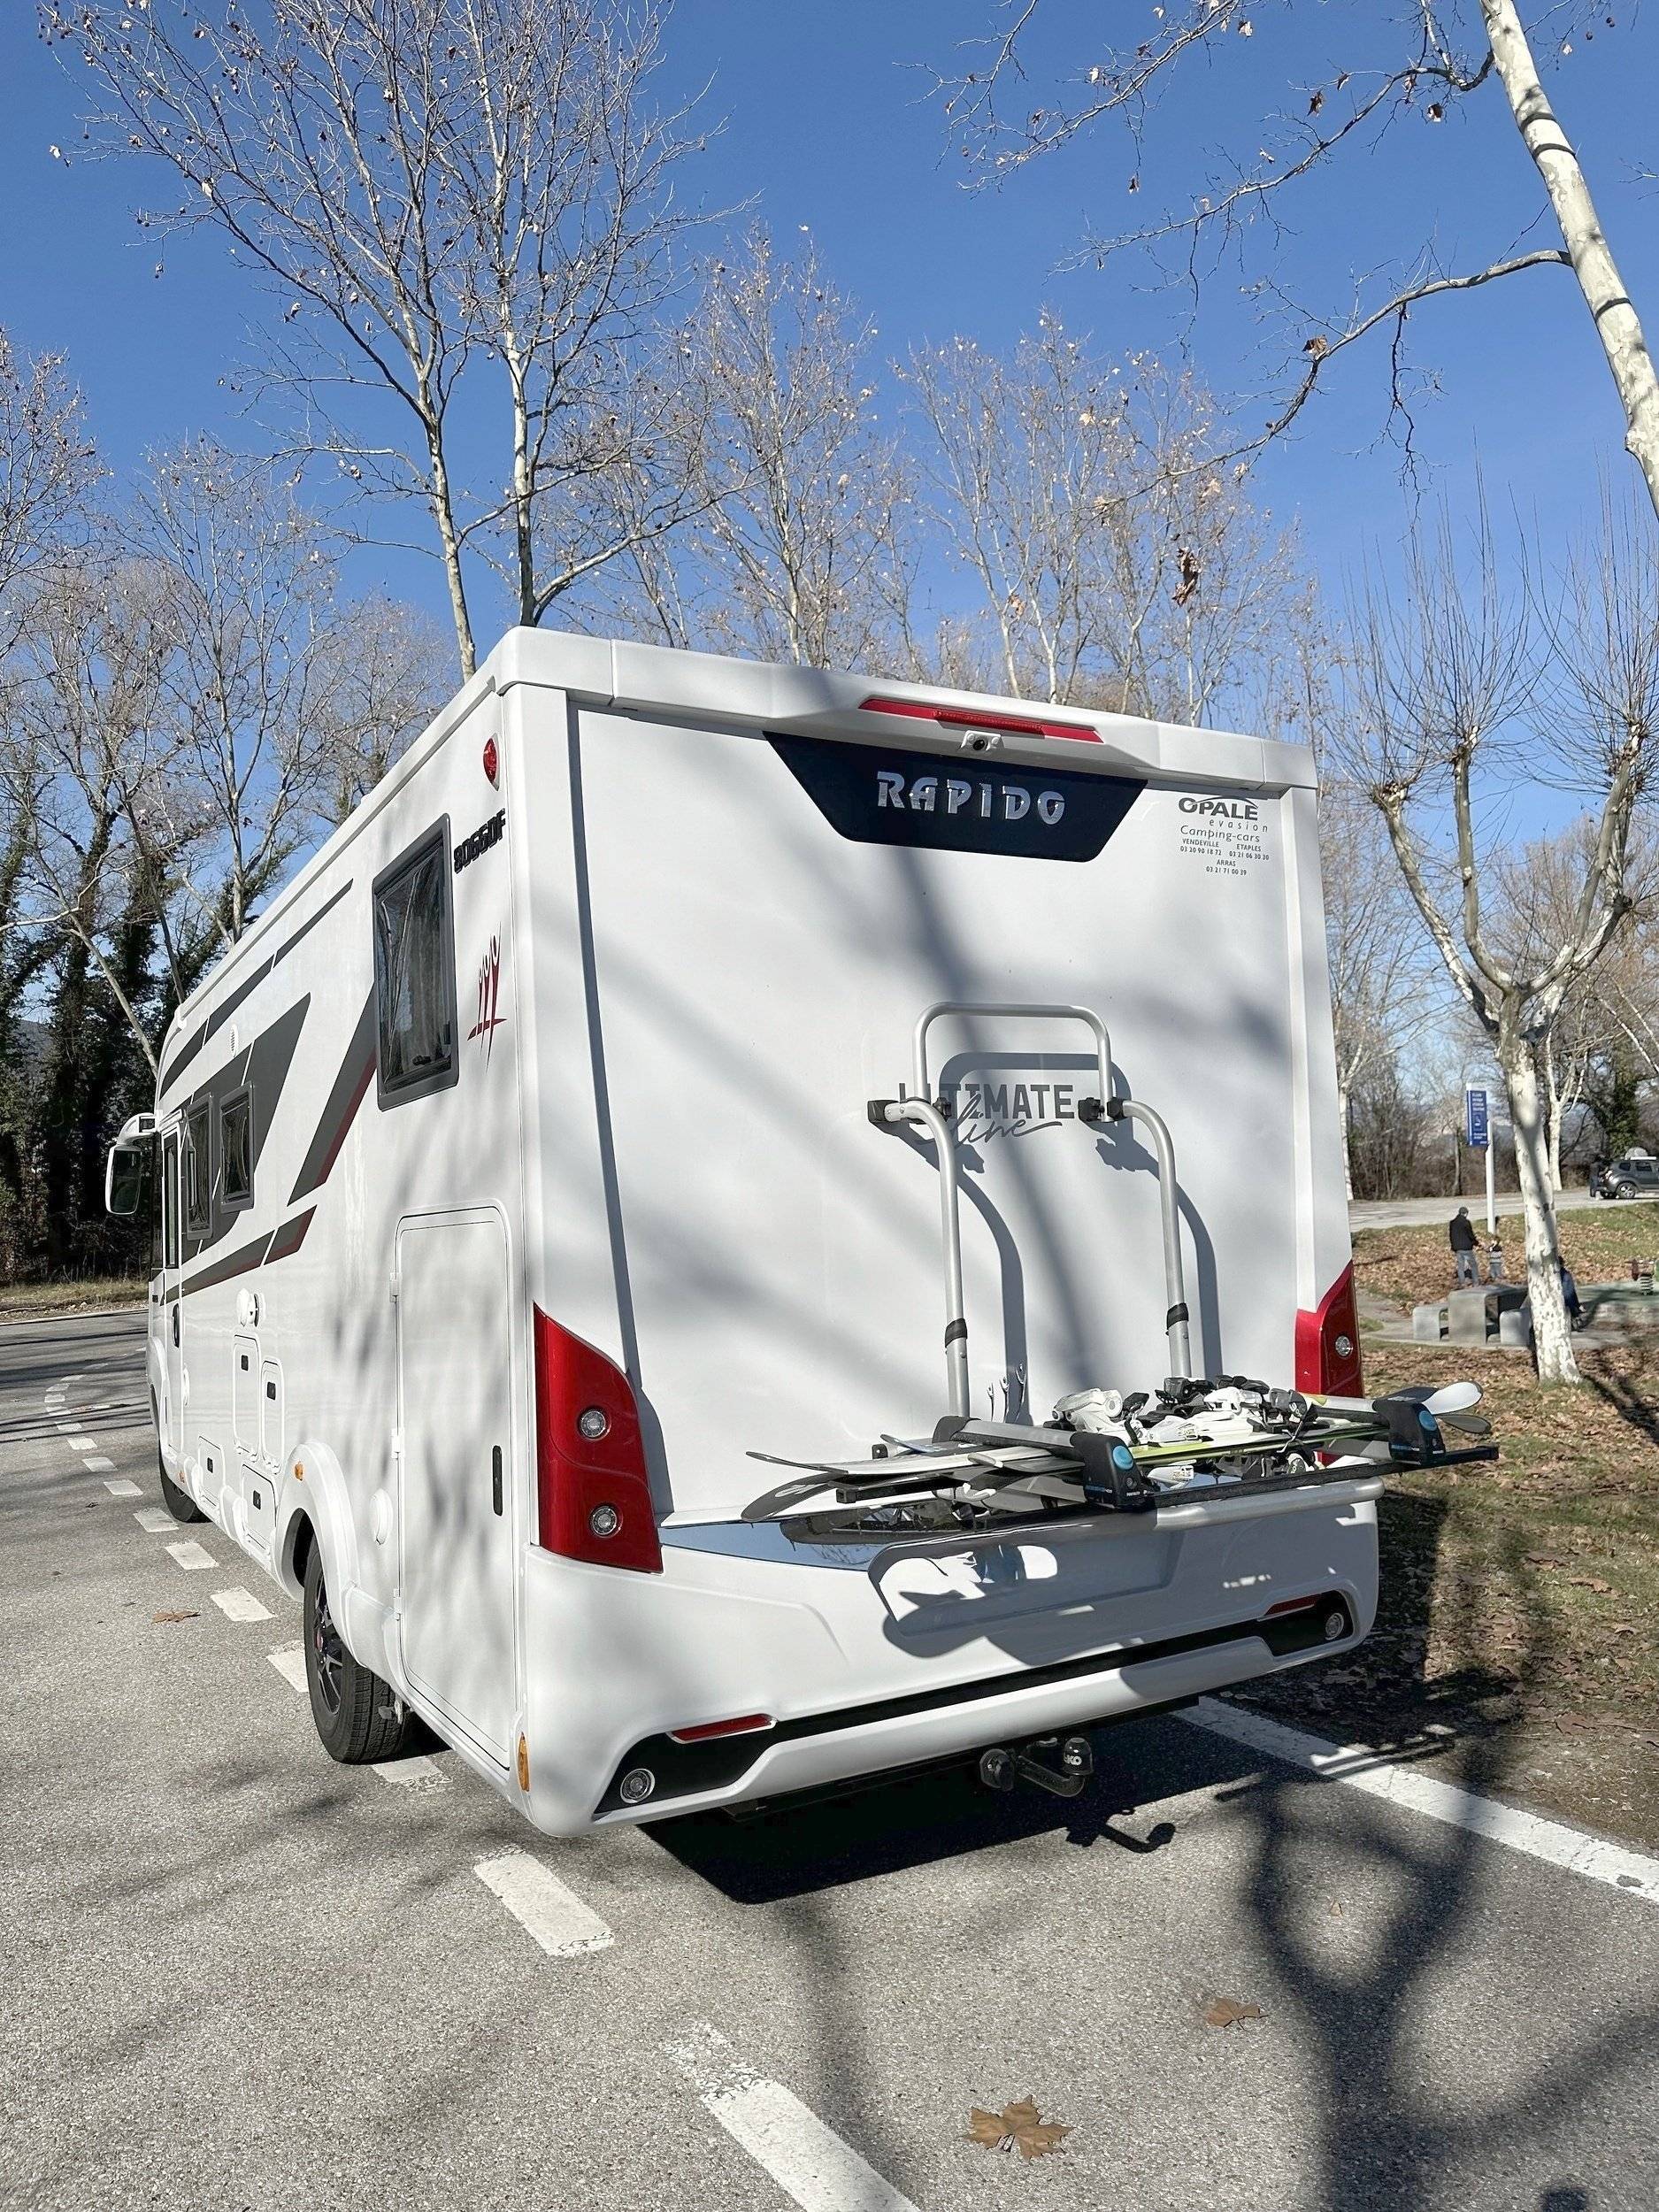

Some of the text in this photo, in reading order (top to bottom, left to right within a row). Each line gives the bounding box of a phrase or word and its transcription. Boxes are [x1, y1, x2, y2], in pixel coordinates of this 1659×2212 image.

[876, 771, 1065, 826] RAPIDO
[1178, 797, 1258, 821] OPALE
[1180, 825, 1261, 843] Camping-cars
[1209, 818, 1268, 833] evasion
[1182, 838, 1220, 848] VENDEVILLE
[1236, 843, 1262, 852] ETAPLES
[899, 1082, 1075, 1119] TIMATE
